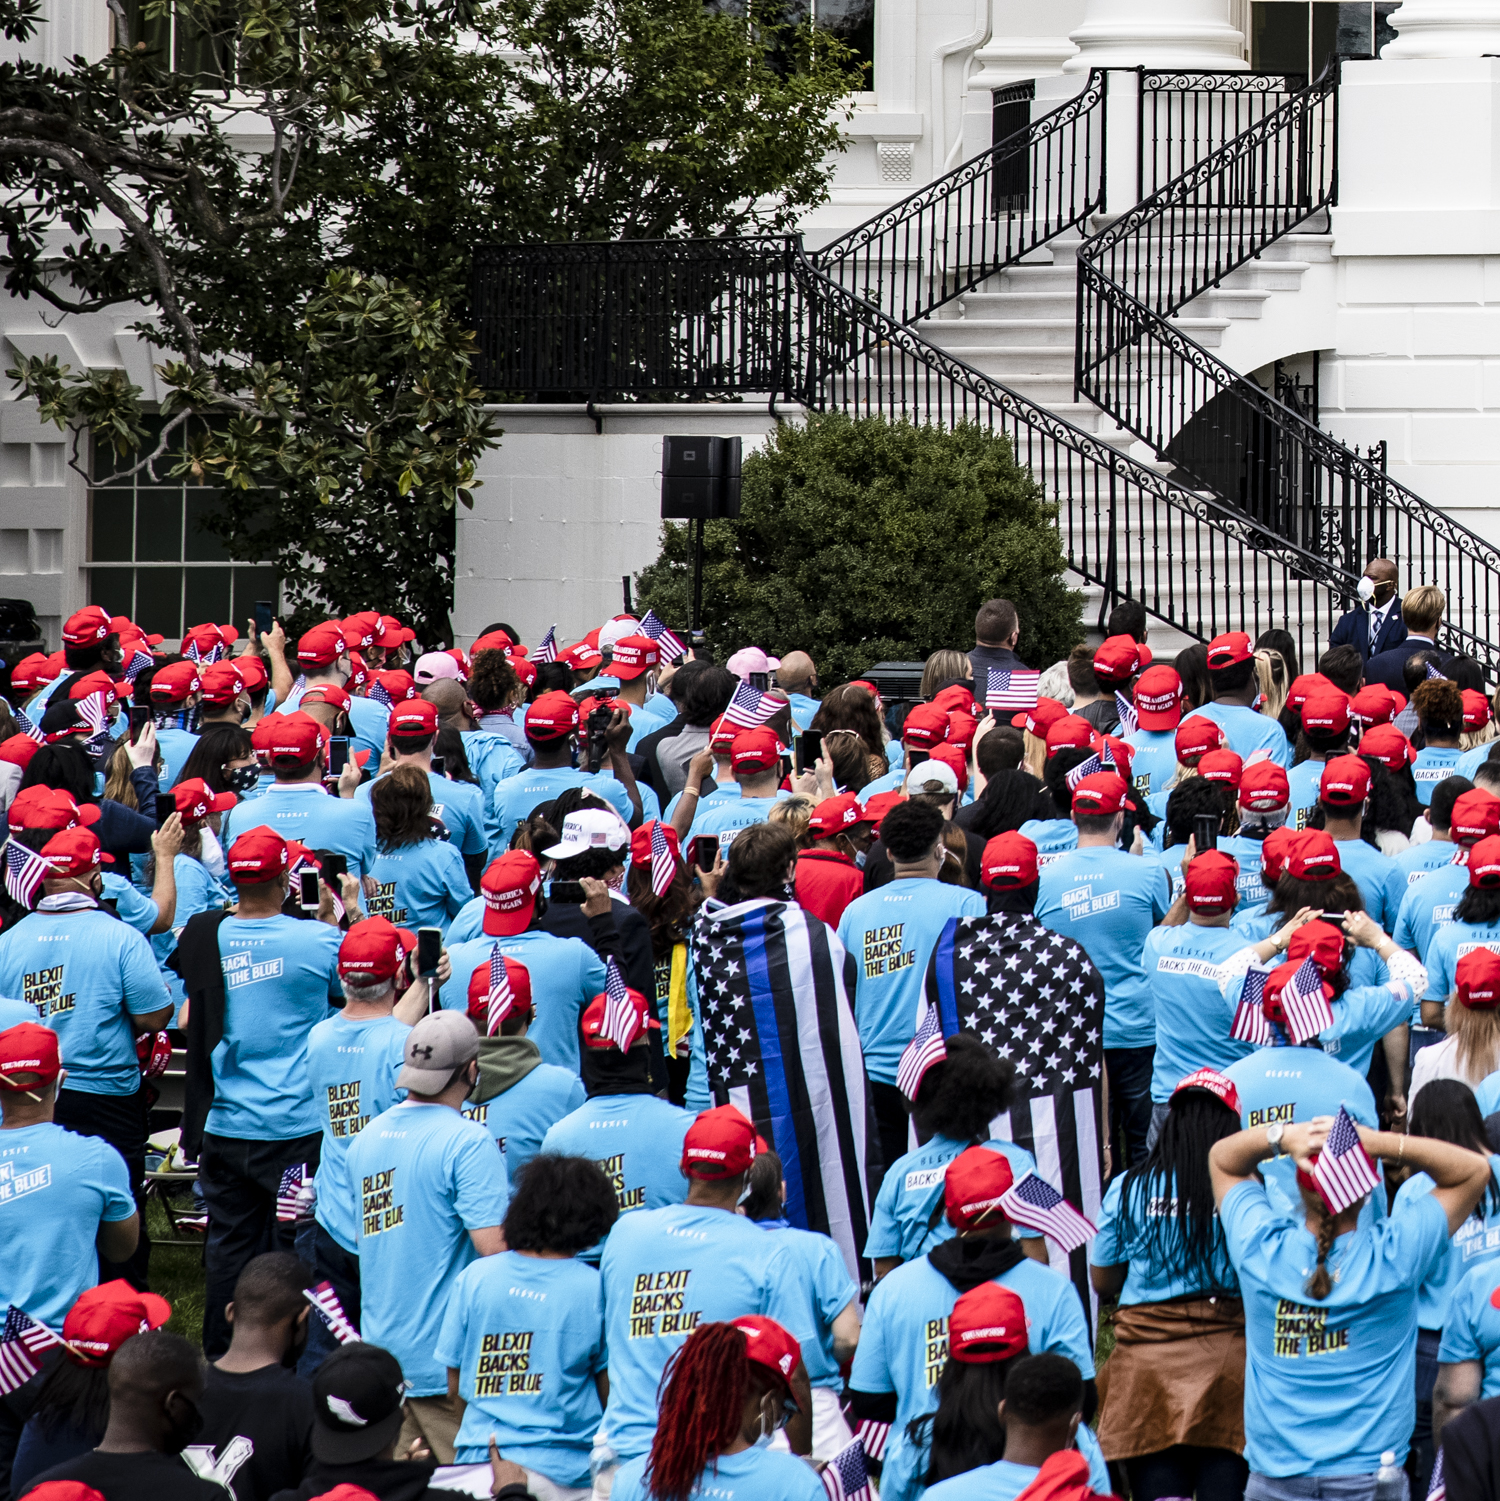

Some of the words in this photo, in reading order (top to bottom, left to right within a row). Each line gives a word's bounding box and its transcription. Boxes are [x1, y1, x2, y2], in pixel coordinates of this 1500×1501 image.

[334, 639, 344, 653] 45
[361, 634, 373, 647] 45
[619, 647, 641, 655] AMERICA
[621, 655, 637, 664] AGAIN
[1151, 692, 1175, 703] AMERICA
[1157, 701, 1174, 710] AGAIN
[1414, 770, 1440, 780] BACKS
[193, 803, 206, 816] 45
[843, 808, 856, 822] 45
[494, 889, 523, 901] AMERICA
[501, 899, 522, 910] AGAIN
[1063, 893, 1090, 909] BACK
[1074, 904, 1090, 917] THE
[1092, 895, 1118, 912] BLUE
[863, 922, 906, 946] BLEXIT
[863, 940, 902, 963] BACKS
[230, 969, 251, 984] THE
[253, 962, 279, 979] BLUE
[864, 959, 884, 979] THE
[888, 949, 916, 975] BLUE
[1159, 960, 1184, 970] BACKS
[1186, 963, 1202, 974] THE
[24, 965, 65, 990] BLEXIT
[25, 984, 63, 1003] BACKS
[49, 993, 77, 1014] BLUE
[328, 1080, 361, 1101] BLEXIT
[329, 1098, 360, 1120] BACKS
[1250, 1103, 1296, 1125] BLEXIT
[330, 1121, 347, 1137] THE
[16, 1169, 48, 1192] BLUE
[362, 1167, 397, 1192] BLEXIT
[907, 1169, 937, 1189] BACKS
[362, 1195, 394, 1214] BACKS
[363, 1215, 381, 1238] THE
[635, 1269, 691, 1292] BLEXIT
[633, 1293, 685, 1315] BACKS
[630, 1315, 657, 1336] THE
[659, 1311, 702, 1334] BLUE
[1275, 1318, 1326, 1334] BACKS
[482, 1331, 534, 1352] BLEXIT
[1274, 1335, 1301, 1356] THE
[1306, 1329, 1349, 1355] BLUE
[478, 1353, 530, 1373] BACKS
[475, 1375, 504, 1396] THE
[508, 1372, 544, 1393] BLUE
